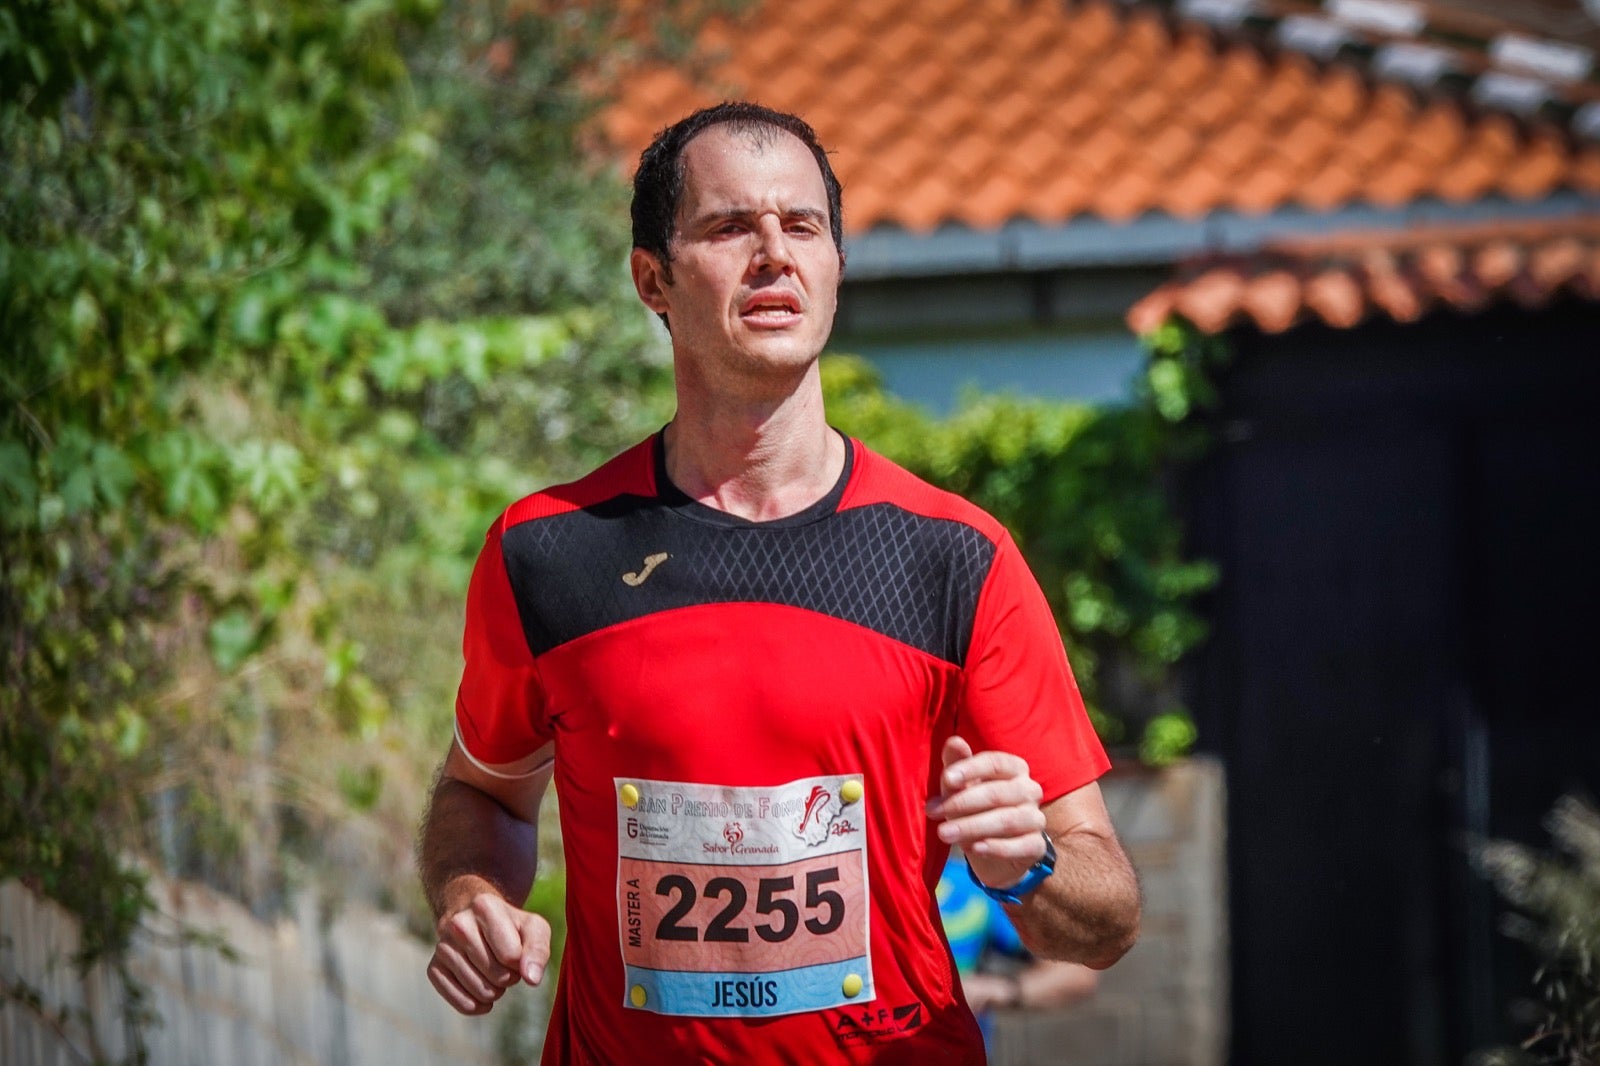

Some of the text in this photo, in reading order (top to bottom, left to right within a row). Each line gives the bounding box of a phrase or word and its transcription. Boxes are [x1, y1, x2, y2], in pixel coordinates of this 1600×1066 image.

[629, 796, 667, 814] RAN
[702, 842, 779, 855] Sabor Granada
[628, 878, 641, 947] MASTER A
[655, 867, 845, 943] 2255
[711, 975, 778, 1008] JESÚS
